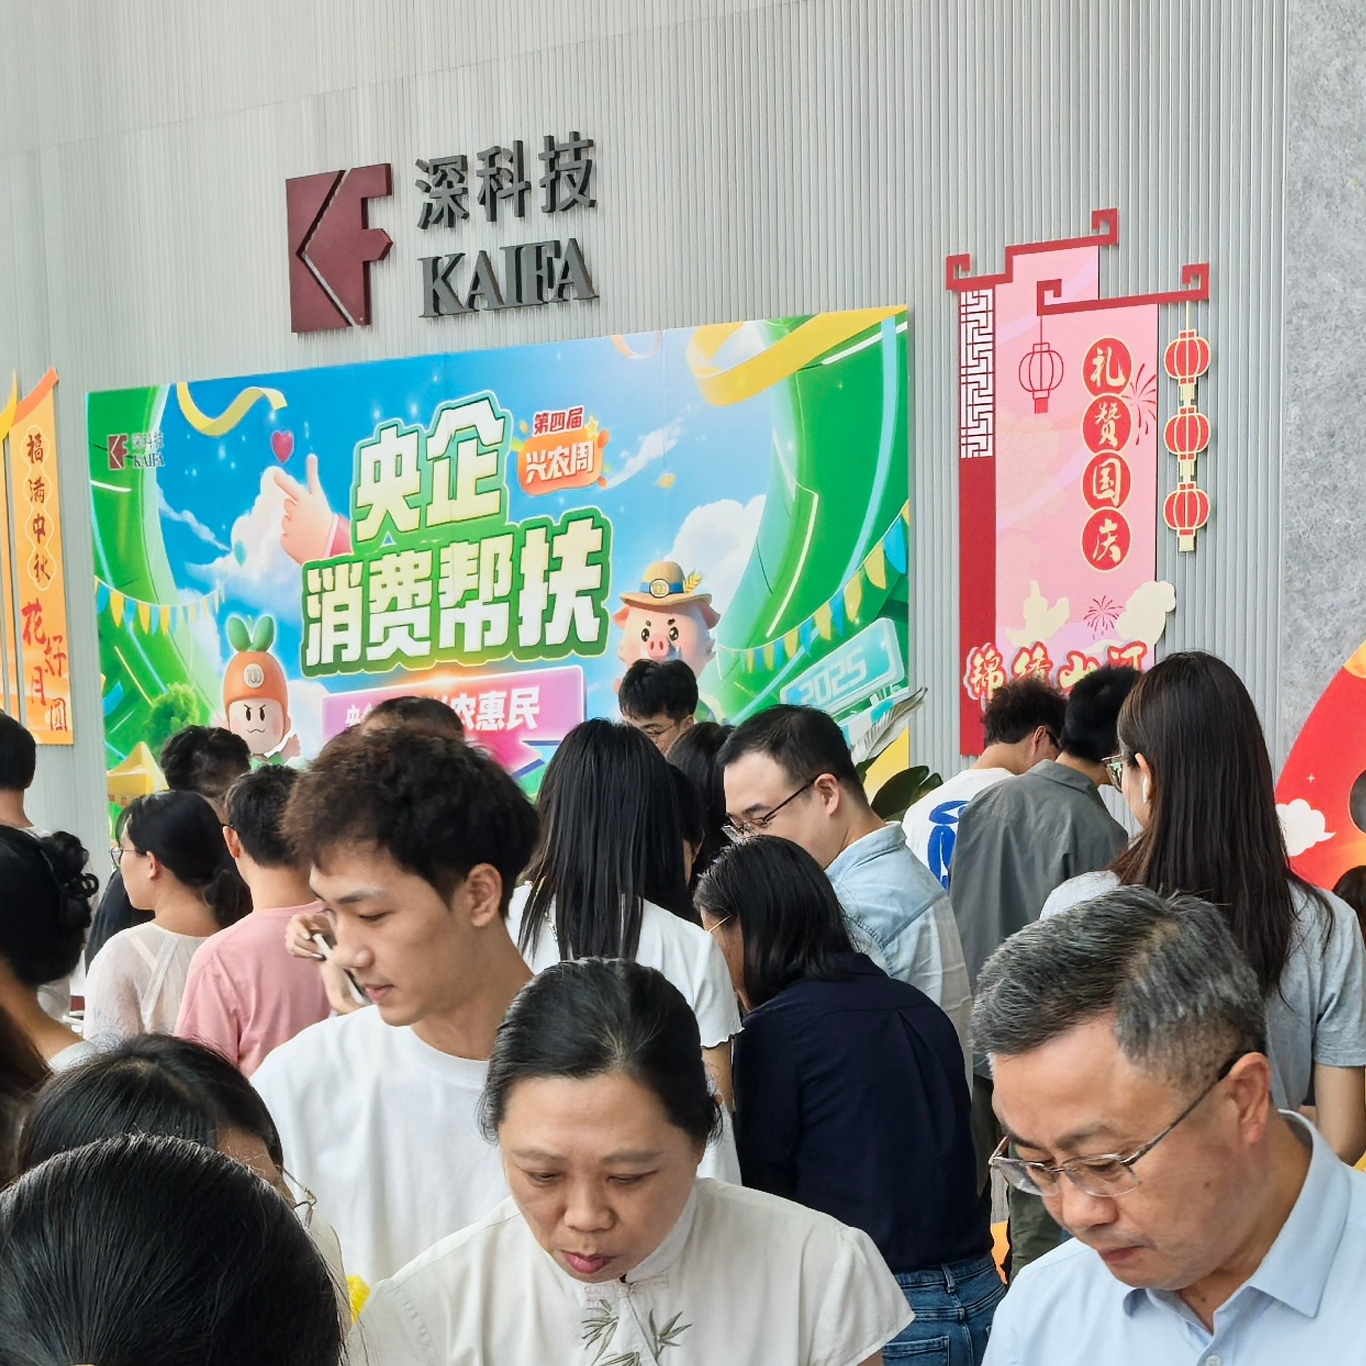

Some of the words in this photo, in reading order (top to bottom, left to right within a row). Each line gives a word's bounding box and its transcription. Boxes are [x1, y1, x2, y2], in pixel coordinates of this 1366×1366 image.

[415, 131, 596, 230] 深科技
[417, 238, 600, 318] KAIFA
[525, 441, 594, 484] 兴农周
[535, 407, 583, 435] 第四届
[1090, 346, 1126, 563] 礼赞国庆
[356, 398, 504, 543] 央企
[306, 518, 603, 667] 消费帮扶
[801, 650, 868, 704] 2025
